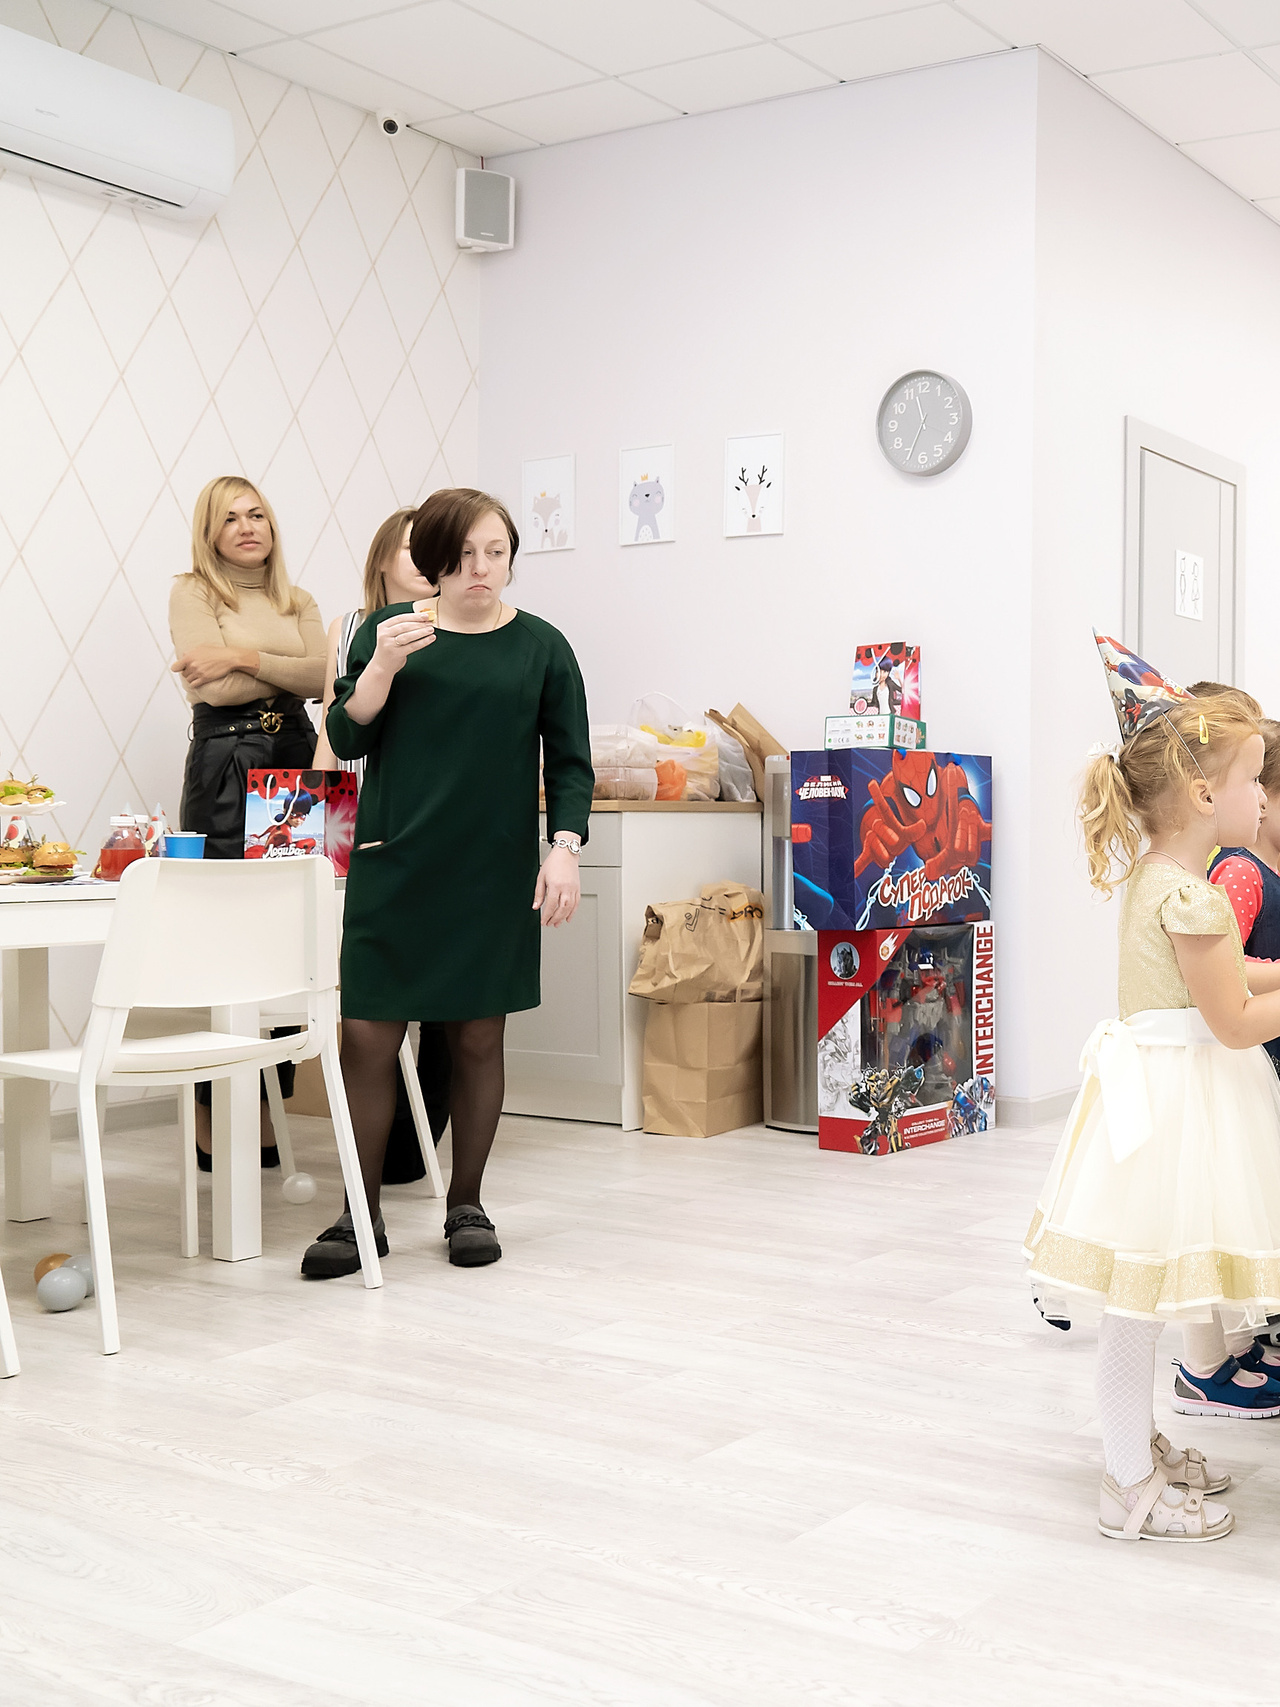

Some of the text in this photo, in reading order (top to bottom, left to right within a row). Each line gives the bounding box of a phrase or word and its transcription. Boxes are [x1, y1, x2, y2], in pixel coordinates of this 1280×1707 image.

[917, 381, 930, 393] 12
[904, 388, 914, 400] 11
[893, 402, 906, 414] 10
[944, 397, 953, 409] 2
[949, 413, 958, 425] 3
[888, 420, 898, 432] 9
[893, 437, 903, 449] 8
[944, 431, 953, 443] 4
[933, 445, 943, 457] 5
[918, 452, 928, 464] 6
[909, 867, 973, 921] ПОДАРОК
[975, 925, 994, 1076] INTERCHANGE
[903, 1119, 946, 1135] INTERCHANGE
